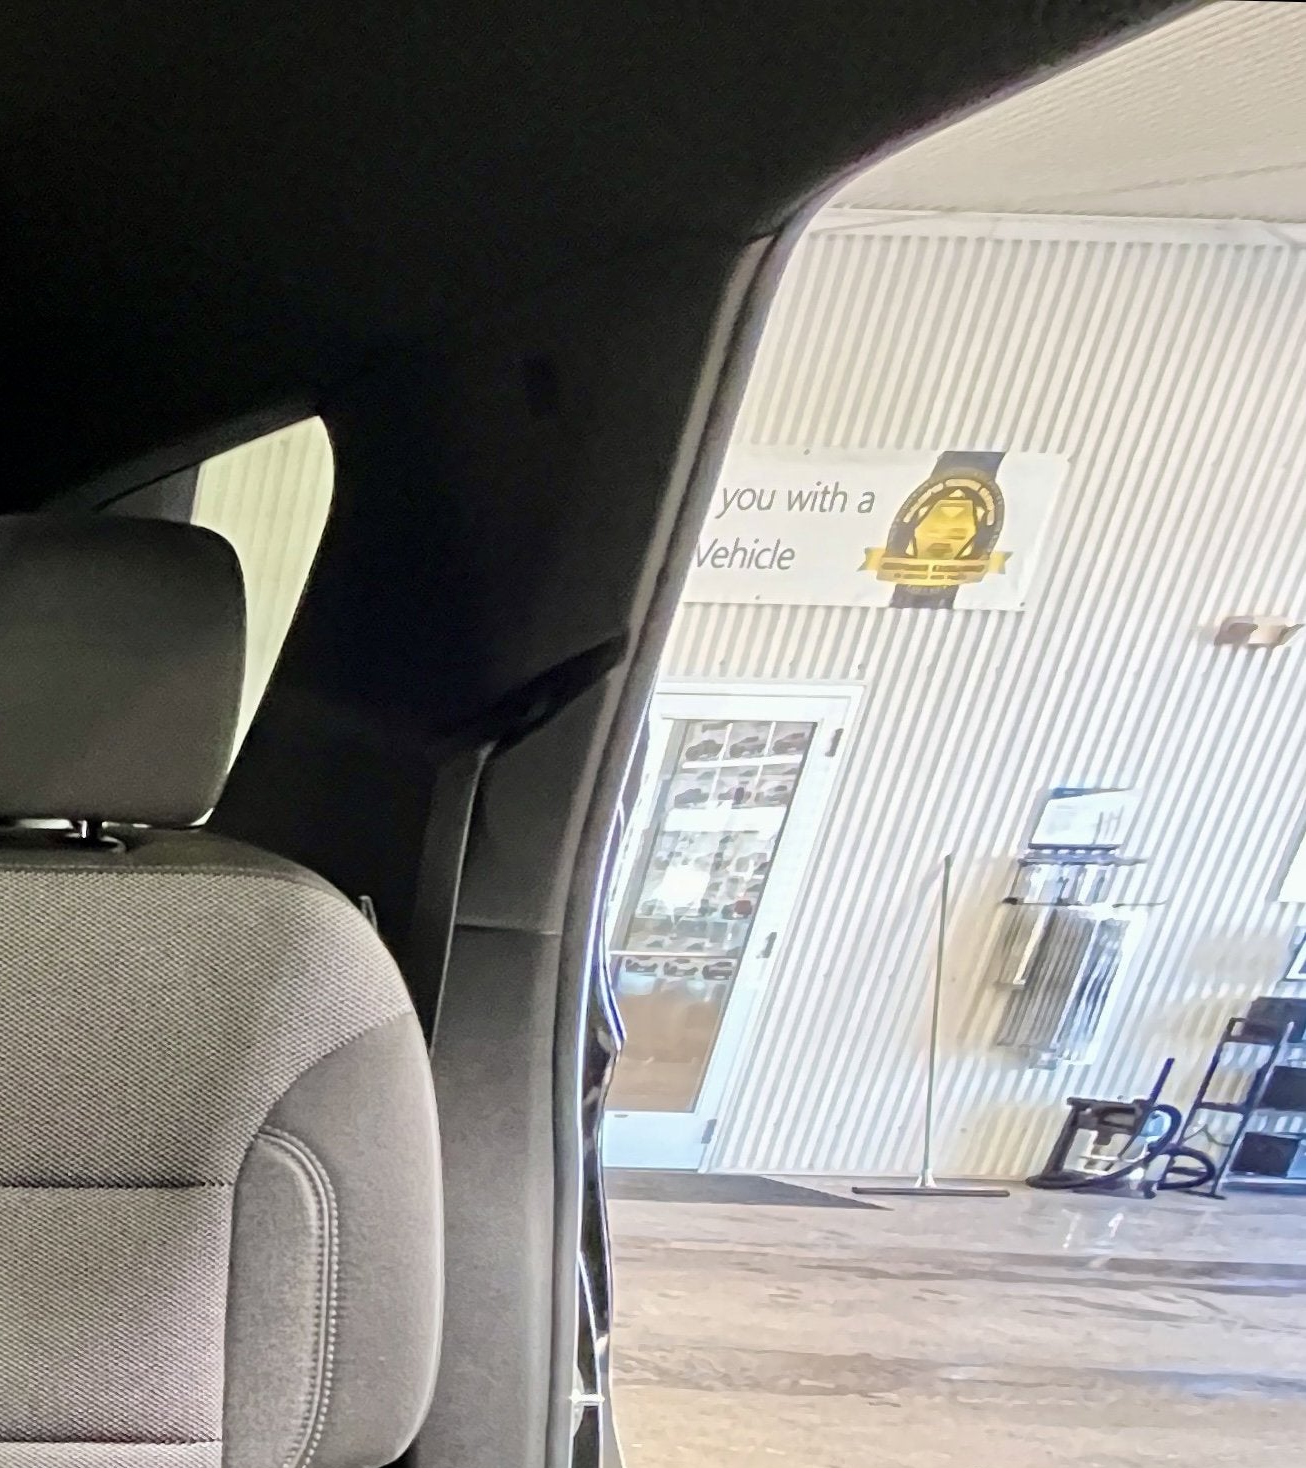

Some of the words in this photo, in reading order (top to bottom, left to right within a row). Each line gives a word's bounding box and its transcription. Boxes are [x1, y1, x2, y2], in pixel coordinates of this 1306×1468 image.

[714, 486, 777, 520] you
[787, 480, 848, 513] with
[856, 490, 876, 514] a
[696, 536, 796, 571] Vehicle
